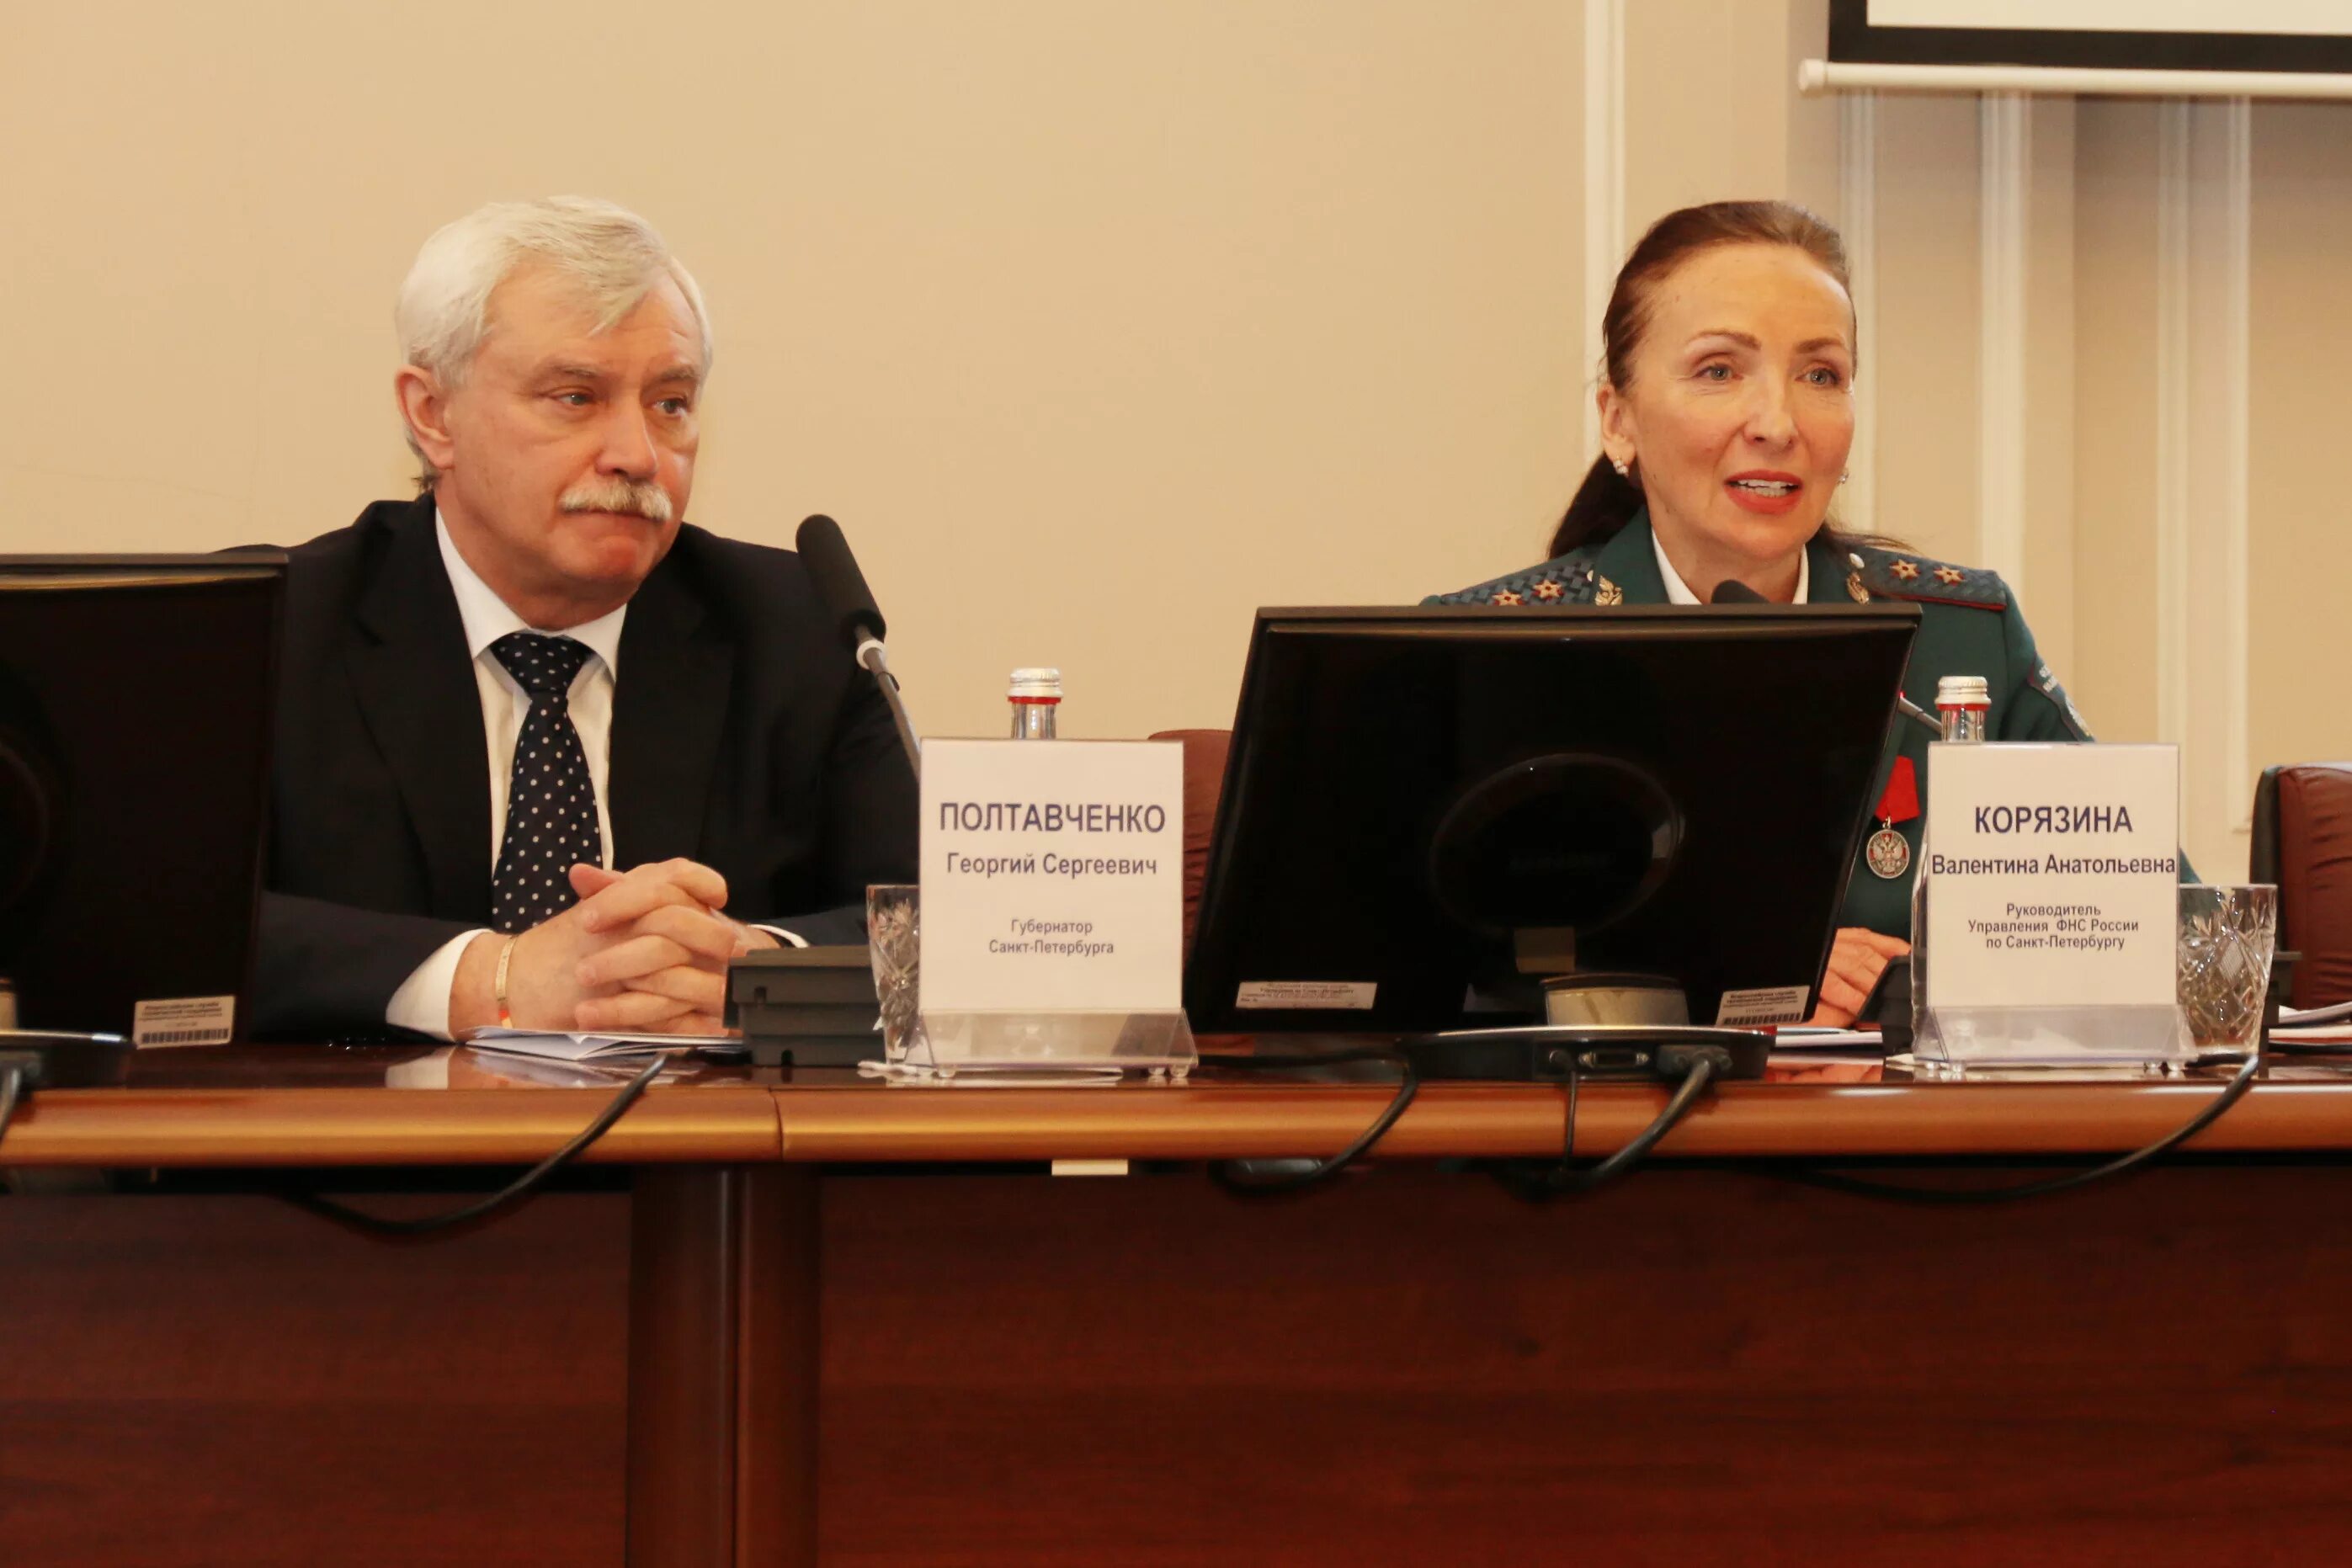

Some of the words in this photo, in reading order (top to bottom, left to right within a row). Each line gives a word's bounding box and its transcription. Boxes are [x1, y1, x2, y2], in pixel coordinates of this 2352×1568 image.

[940, 802, 1165, 833] ПОЛТАВЧЕНКО
[1976, 805, 2133, 834] КОРЯЗИНА
[948, 853, 1035, 879] Георгий
[1043, 853, 1156, 880] Сергеевич
[1932, 854, 2039, 874] Валентина
[2045, 853, 2175, 874] Анатольевна
[2007, 902, 2100, 918] Руководитель
[1012, 919, 1093, 936] Губернатор
[1968, 917, 2048, 934] Управления
[2057, 917, 2086, 932] ФНС
[2091, 918, 2138, 932] России
[990, 939, 1113, 957] Санкт-Петербурга
[1987, 938, 2002, 949] по
[2006, 934, 2125, 951] Санкт-Петербургу
